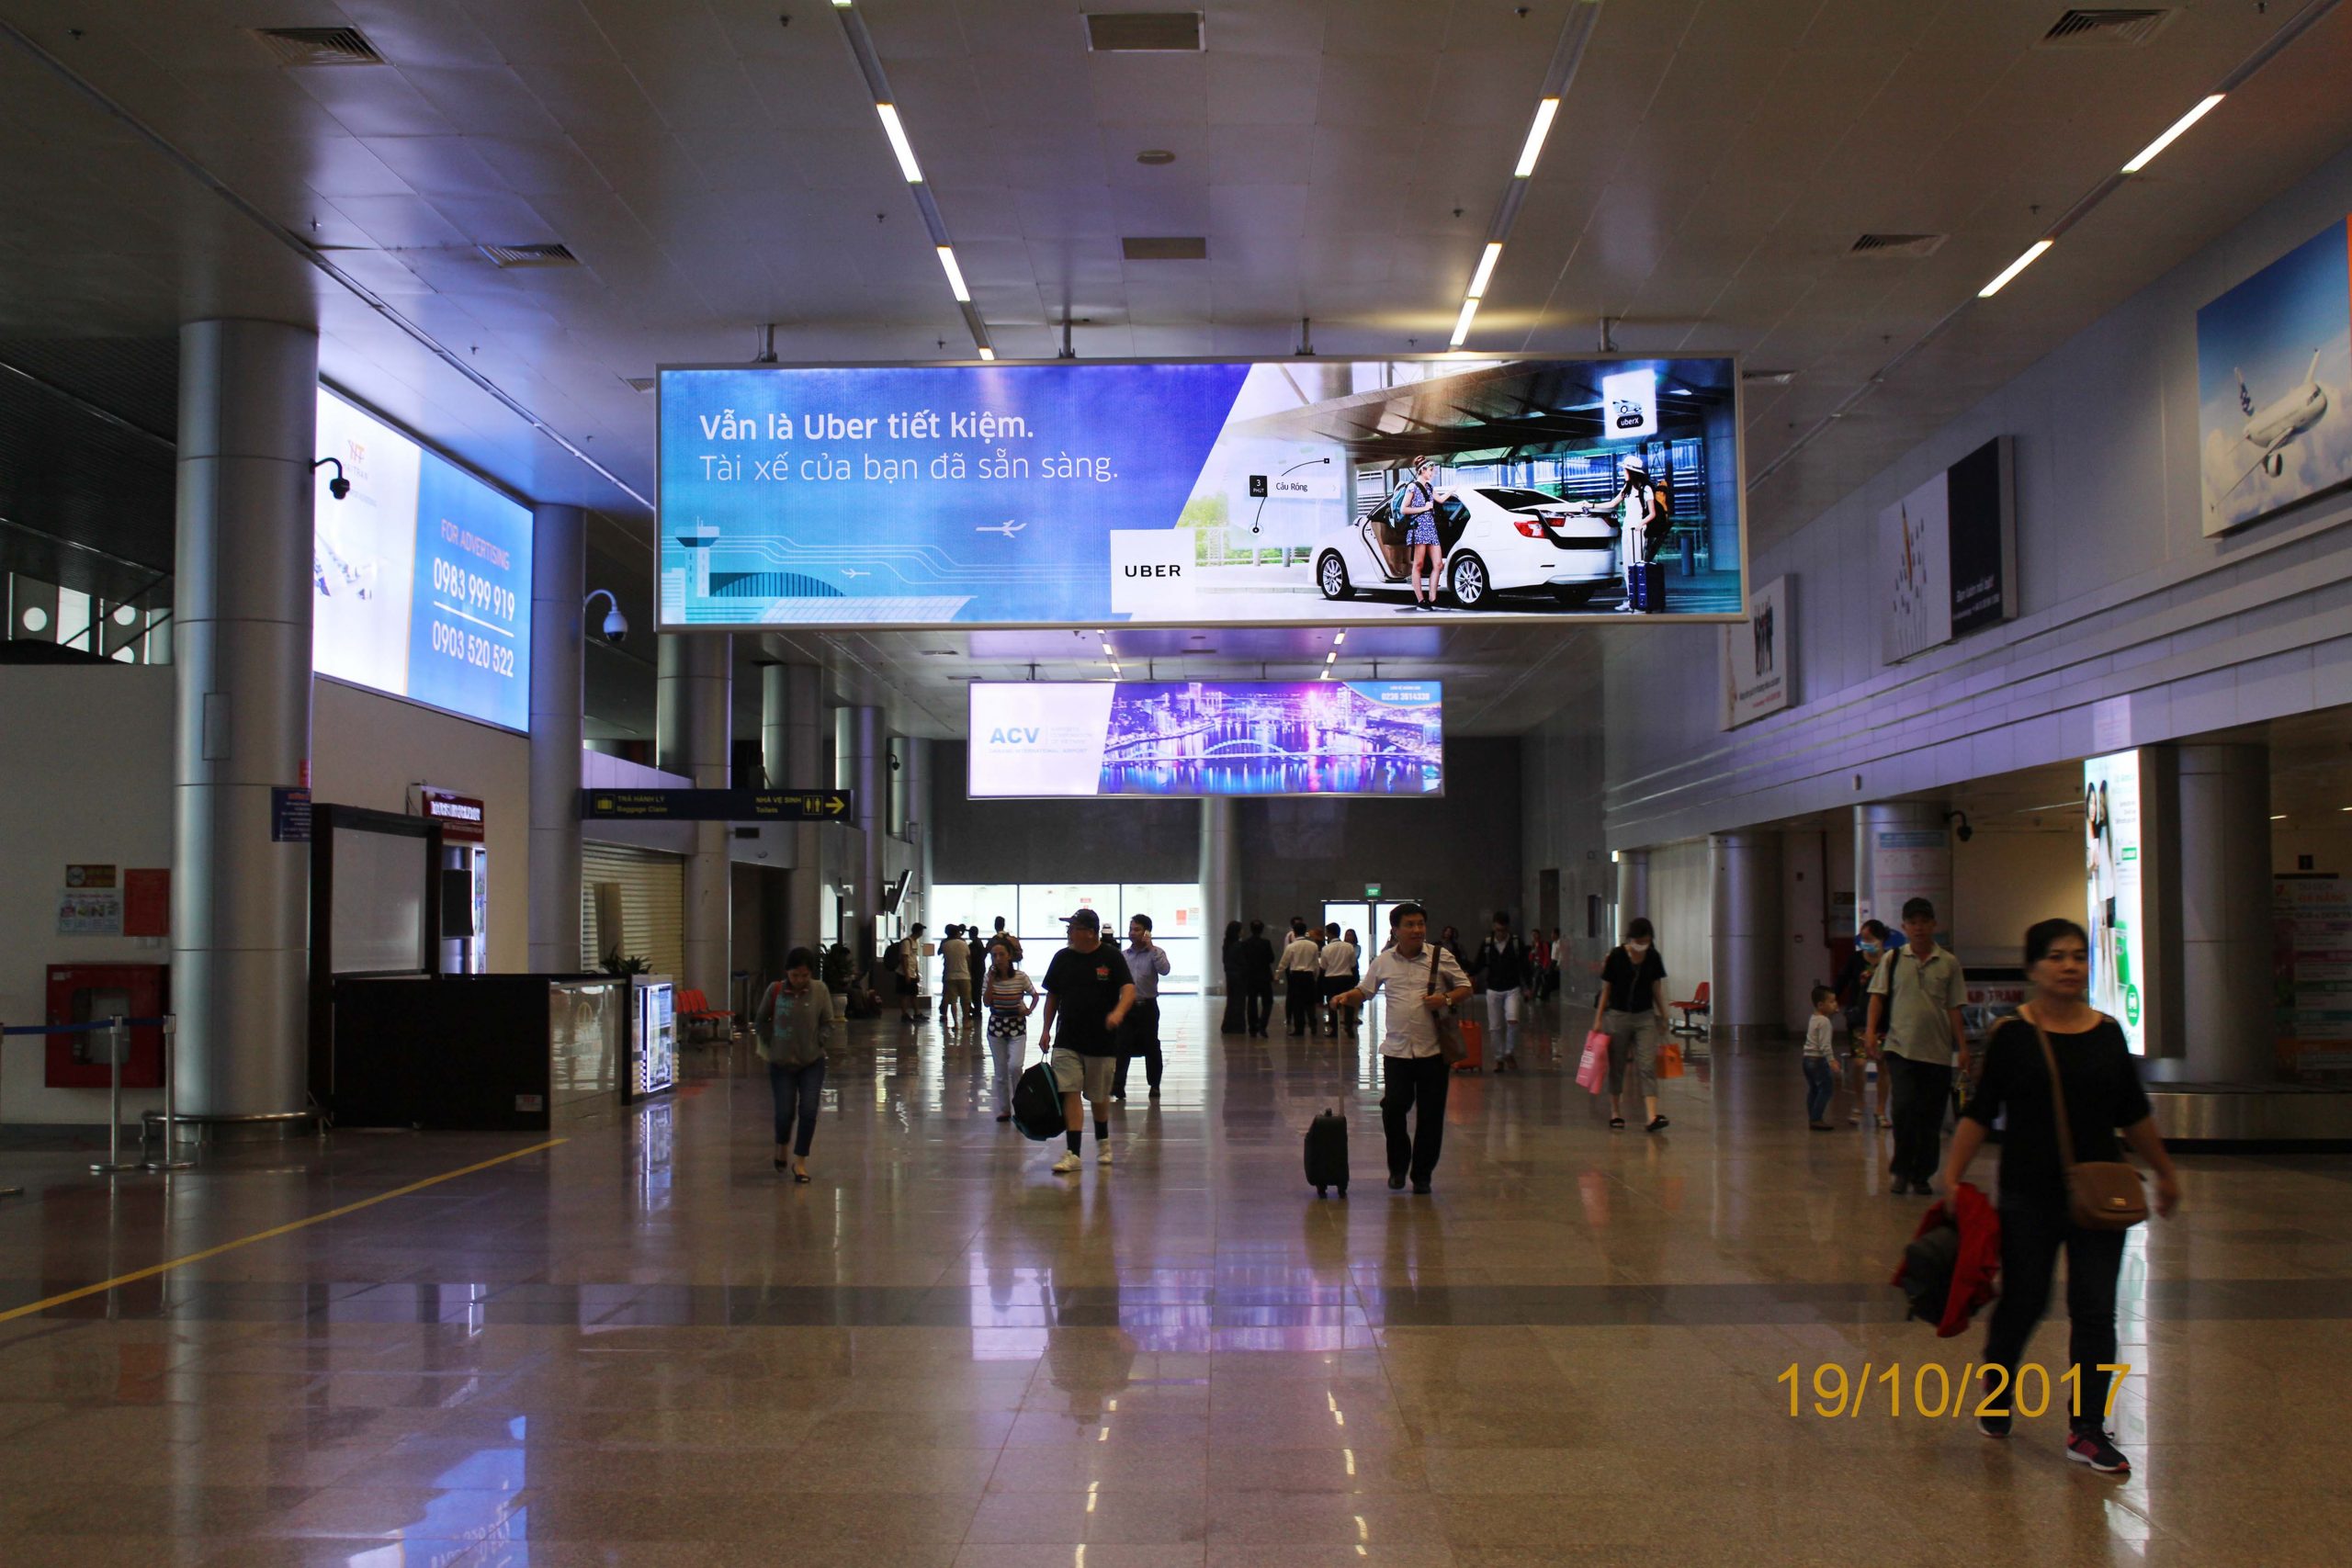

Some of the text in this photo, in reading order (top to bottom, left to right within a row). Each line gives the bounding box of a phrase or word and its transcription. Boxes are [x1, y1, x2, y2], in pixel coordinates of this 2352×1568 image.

[699, 408, 1034, 444] Vẫn là Uber tiết kiệm.
[1620, 417, 1639, 426] uberX
[699, 447, 1118, 484] Tài xế của bạn đã sẵn sàng.
[1256, 479, 1261, 487] 3
[440, 517, 510, 571] FOR ADVERTISING
[1125, 564, 1182, 578] UBER
[433, 557, 515, 622] 0983 999 919
[432, 620, 514, 678] 0903 520 522
[989, 727, 1040, 744] ACV
